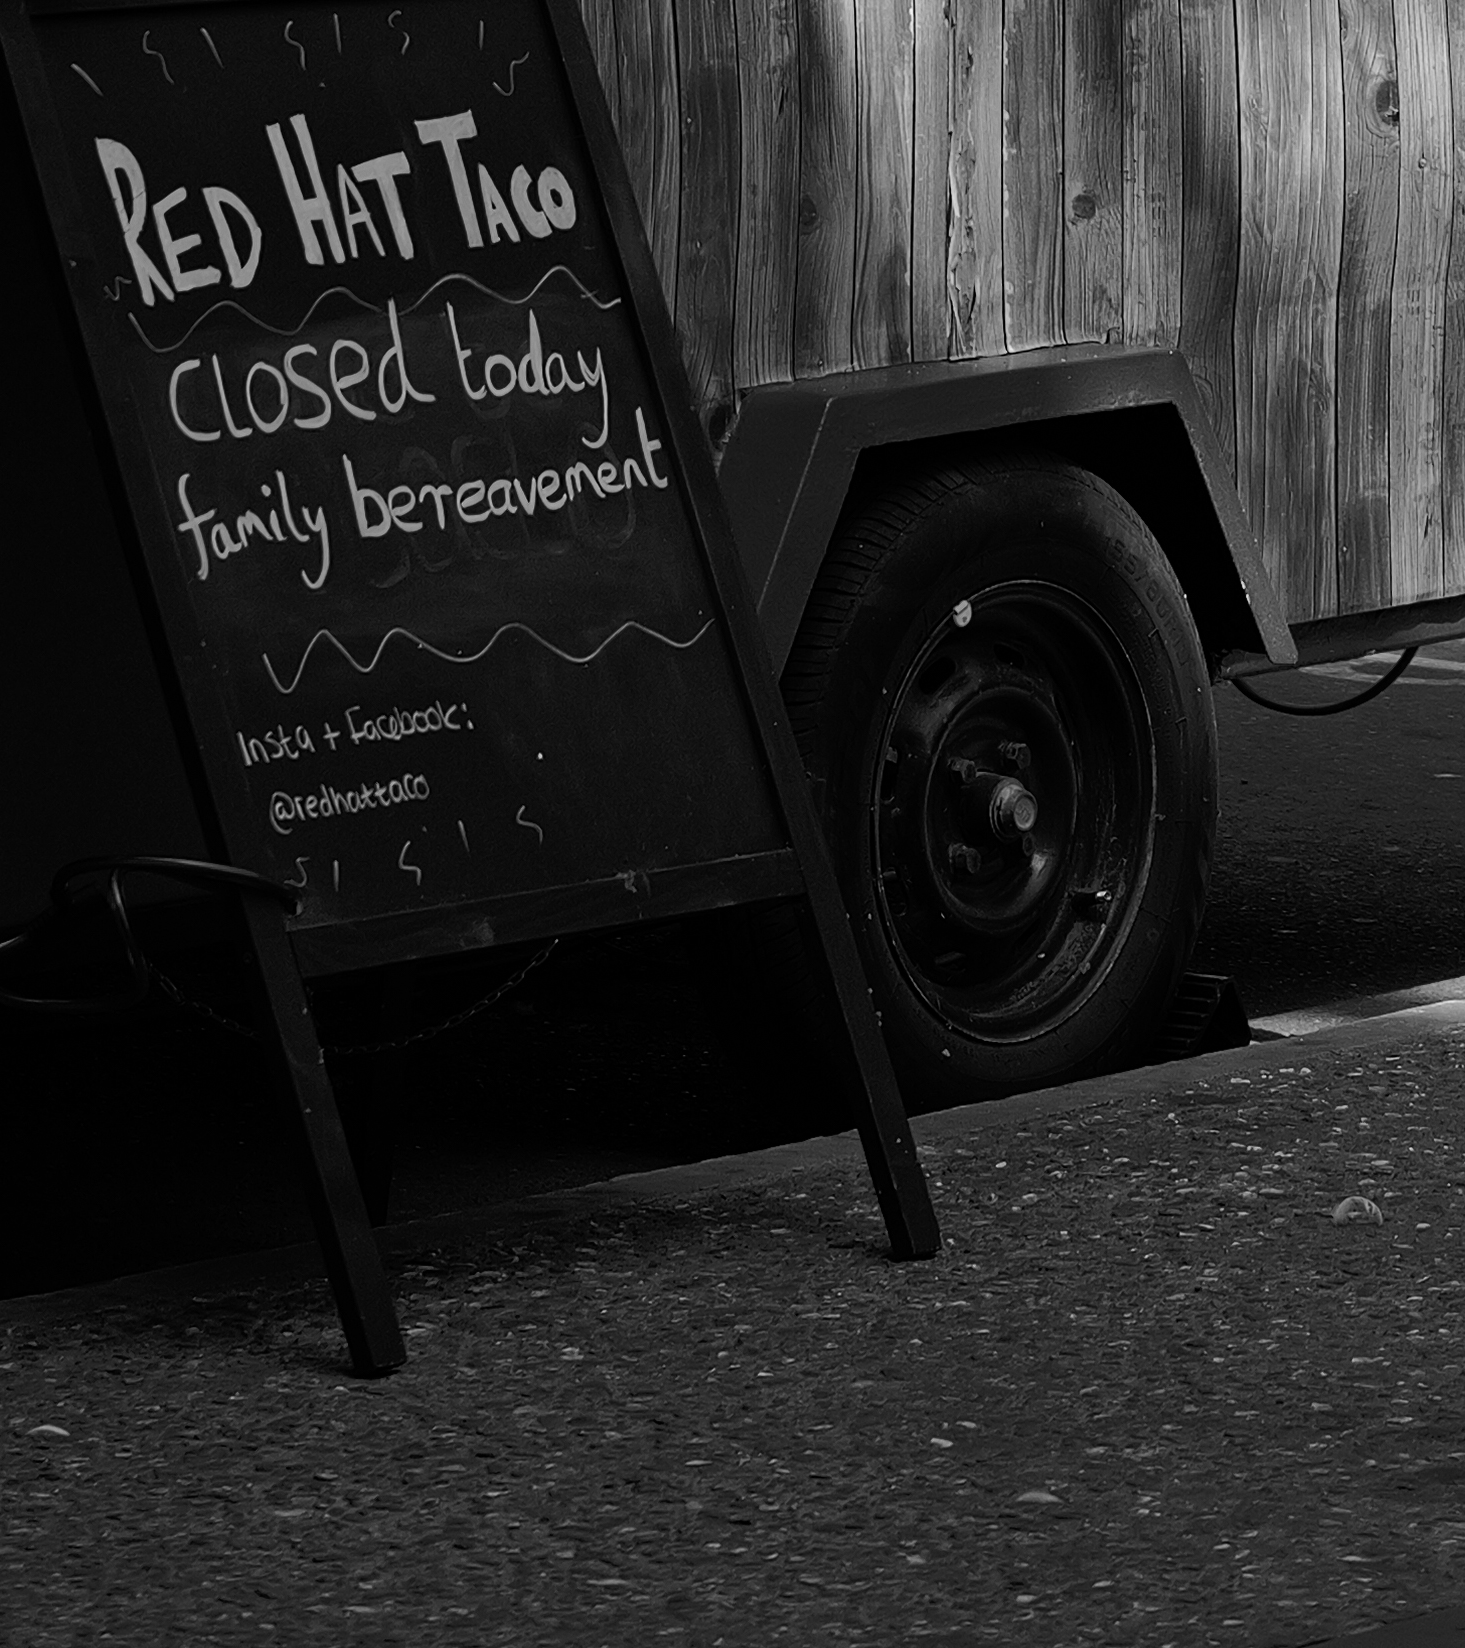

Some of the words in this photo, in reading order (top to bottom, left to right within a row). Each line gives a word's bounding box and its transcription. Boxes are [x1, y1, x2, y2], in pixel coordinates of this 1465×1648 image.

[94, 135, 262, 307] RED
[265, 112, 416, 268] HAT
[413, 108, 577, 249] TACO
[445, 299, 611, 449] today
[176, 469, 331, 591] family
[343, 407, 668, 541] bereavement
[236, 724, 314, 767] Insta
[347, 701, 476, 746] Facebook:
[268, 771, 431, 834] @redhattaco
